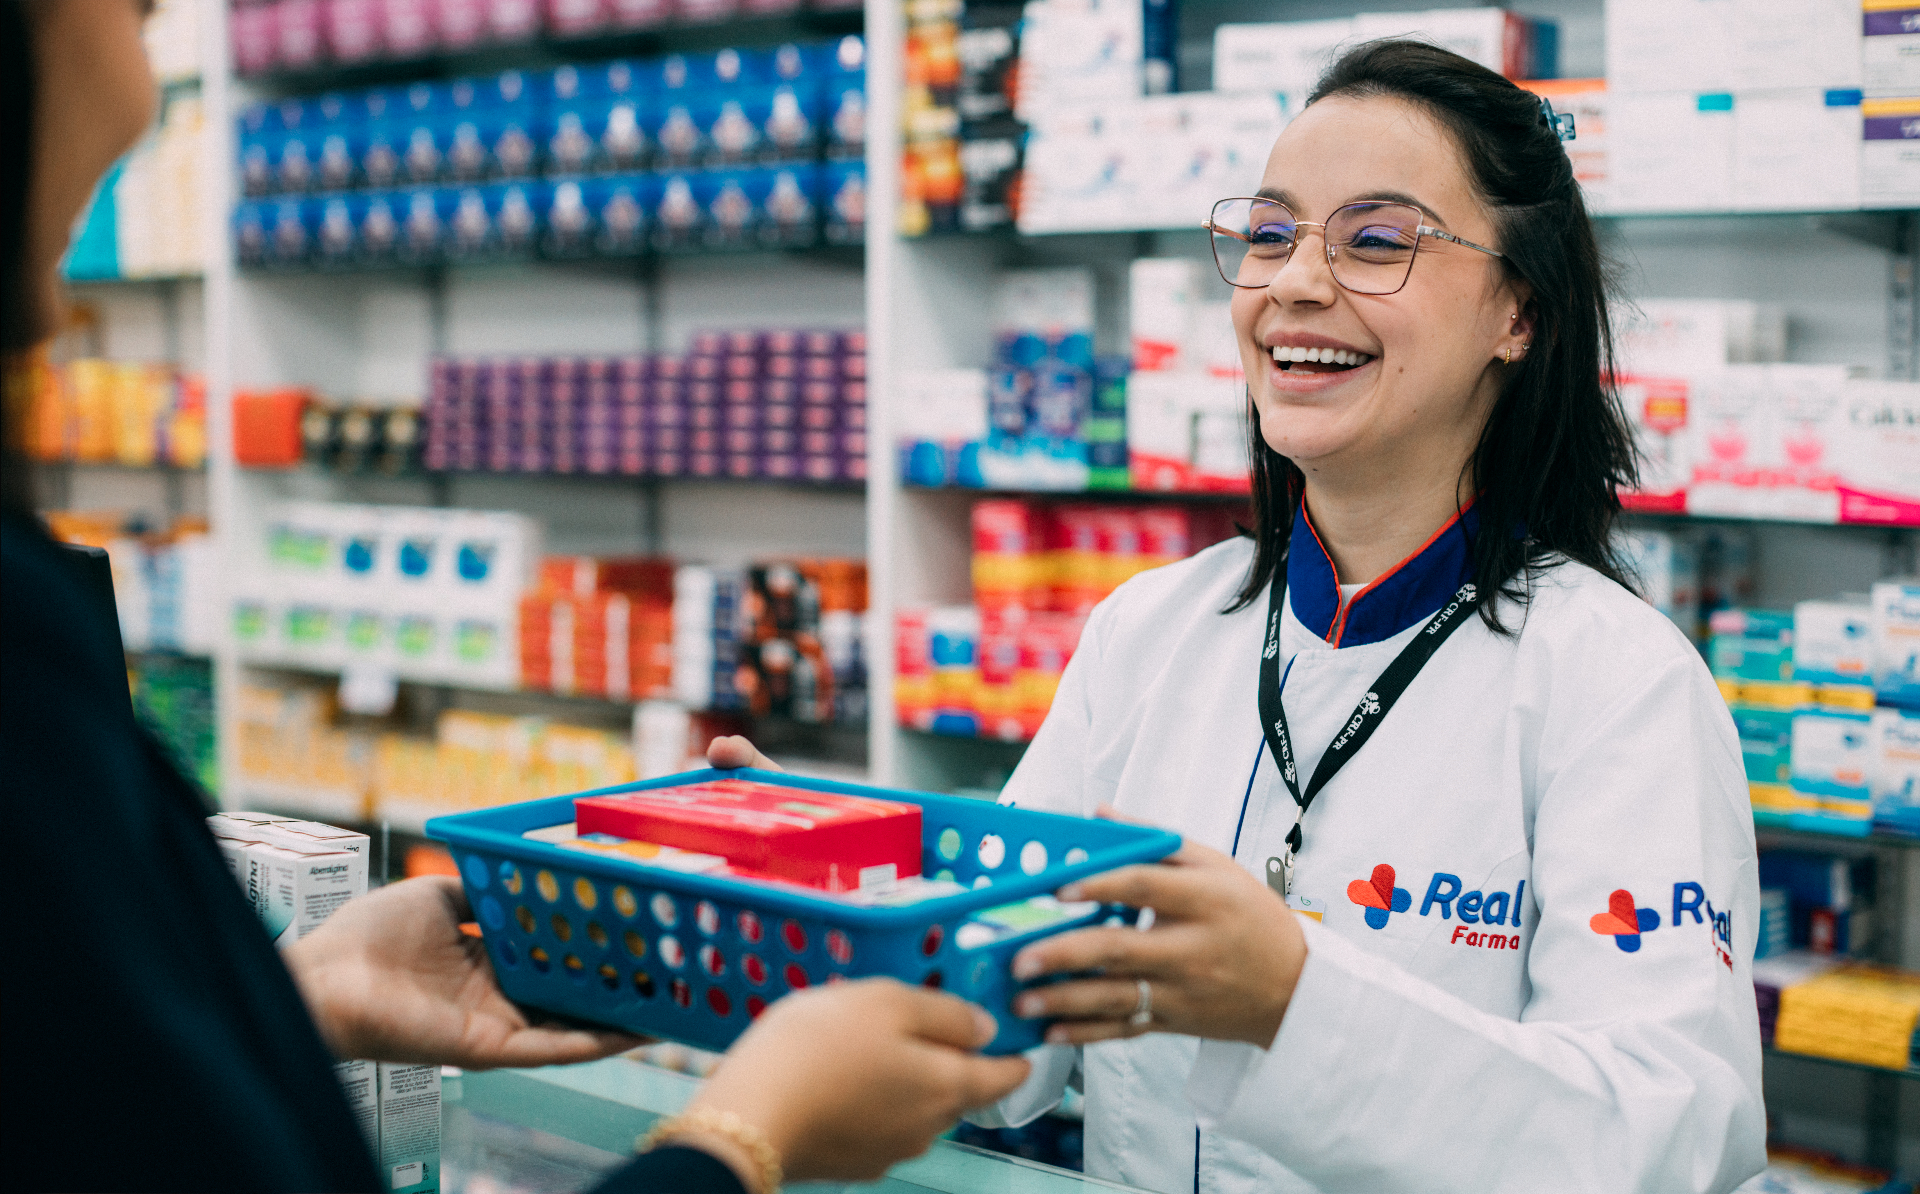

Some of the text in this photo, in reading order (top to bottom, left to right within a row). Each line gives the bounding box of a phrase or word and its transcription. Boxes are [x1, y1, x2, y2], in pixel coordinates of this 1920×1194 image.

[1425, 602, 1459, 635] CRF-PR
[1274, 718, 1290, 760] CRF-PR
[1332, 714, 1364, 750] CRF-PR
[1419, 872, 1526, 928] Real
[1451, 924, 1521, 951] Farma
